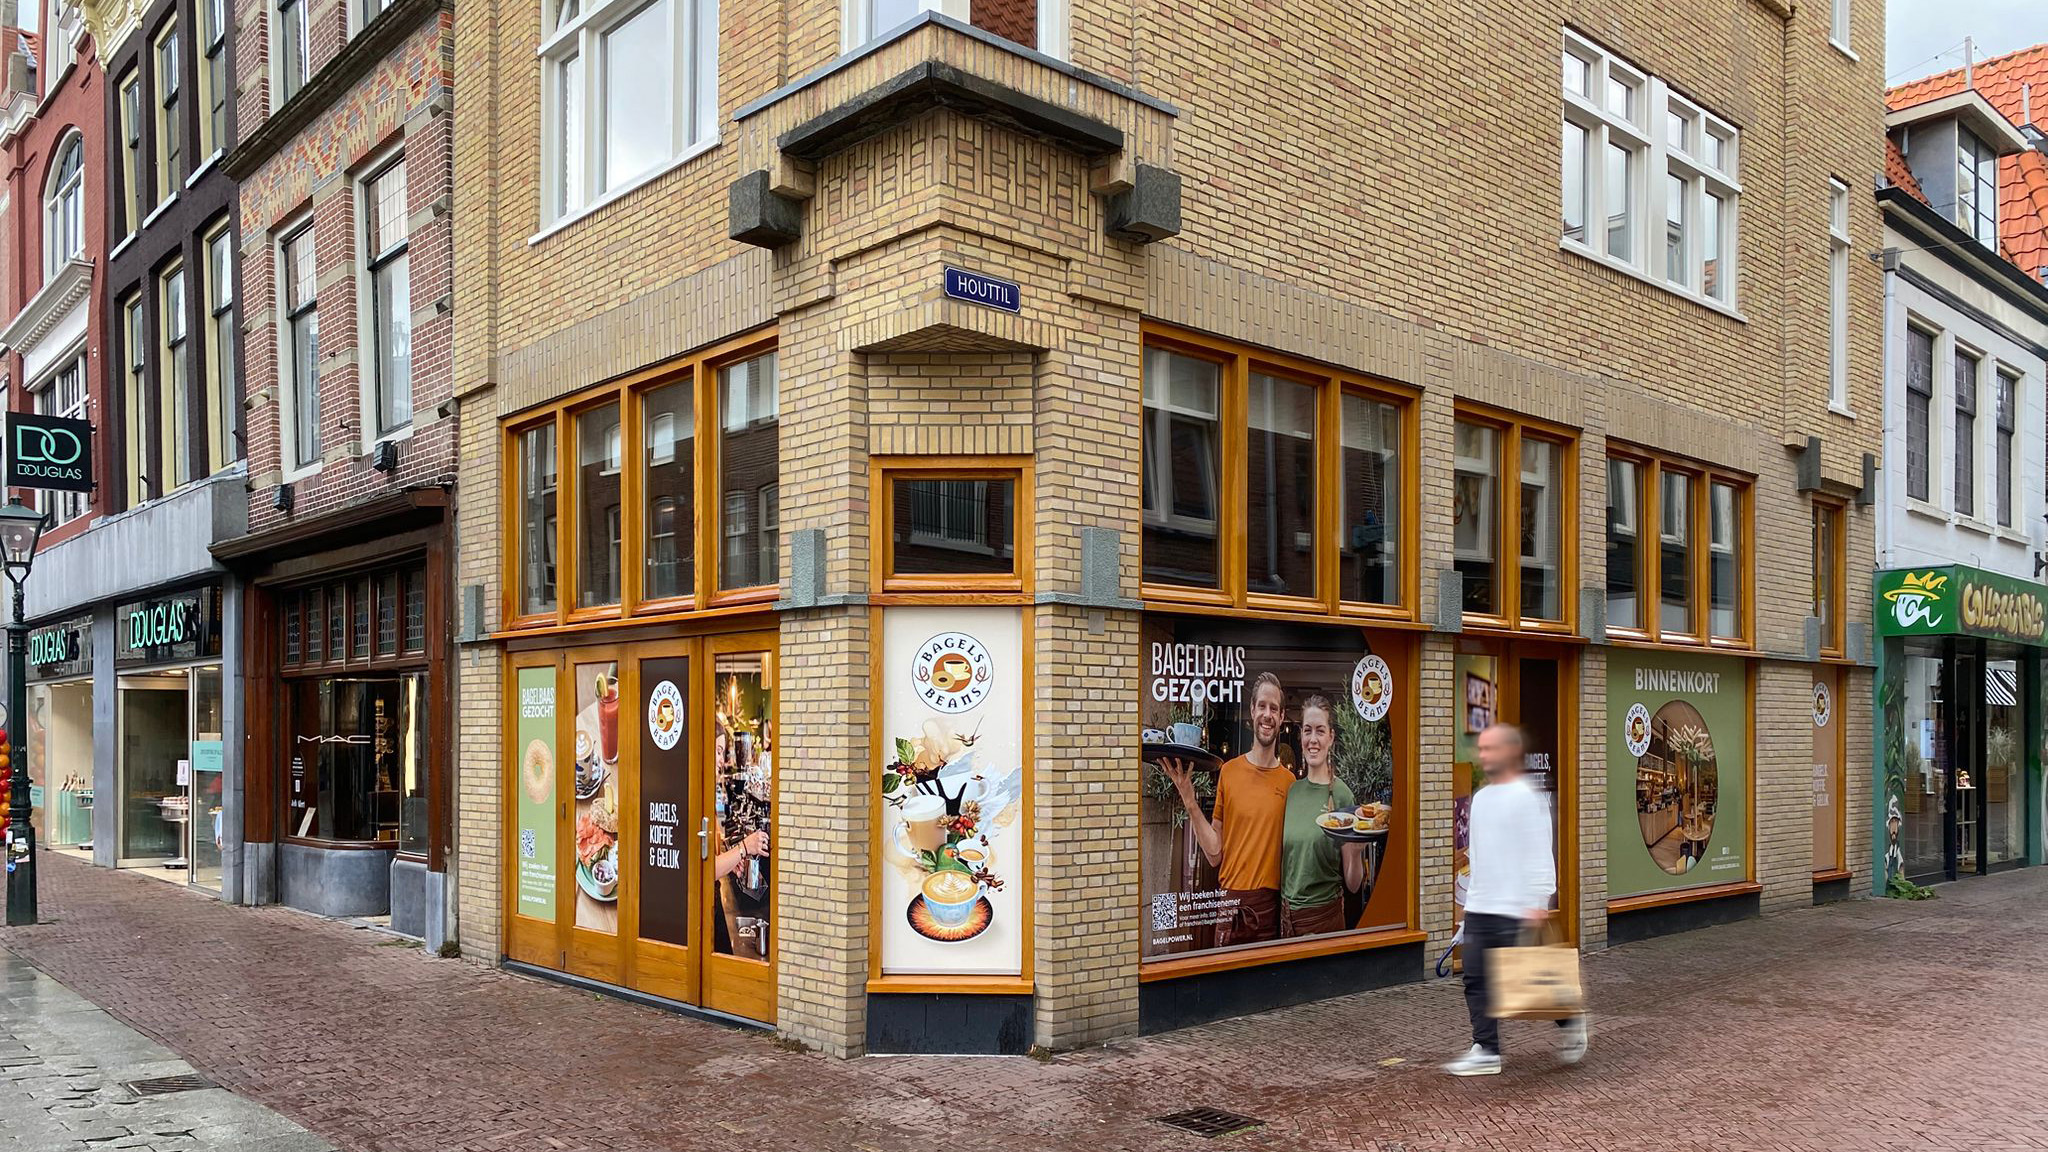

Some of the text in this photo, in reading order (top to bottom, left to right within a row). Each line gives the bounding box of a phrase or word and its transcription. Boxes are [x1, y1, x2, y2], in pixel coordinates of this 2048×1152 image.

[958, 275, 1011, 304] HOUTTIL
[17, 463, 82, 480] DOUGLAS
[130, 601, 184, 649] DOUGLAS
[31, 628, 66, 666] DOUGLAS
[921, 637, 984, 663] BAGELS
[1152, 642, 1245, 678] BAGELBAAS
[1356, 658, 1388, 680] BAGELS
[1152, 677, 1245, 703] GEZOCHT
[1635, 668, 1720, 694] BINNENKORT
[652, 685, 680, 707] BAGELS
[925, 687, 982, 708] BEANS
[522, 705, 554, 718] GEZOCHT
[1358, 700, 1387, 717] BEANS
[653, 728, 679, 746] BEANS
[649, 802, 679, 826] BAGELS,
[649, 825, 673, 846] KOFFIE
[649, 847, 680, 869] & GELUK
[1178, 888, 1228, 903] Wij zoeken hier
[1179, 898, 1241, 912] een franchisenemer
